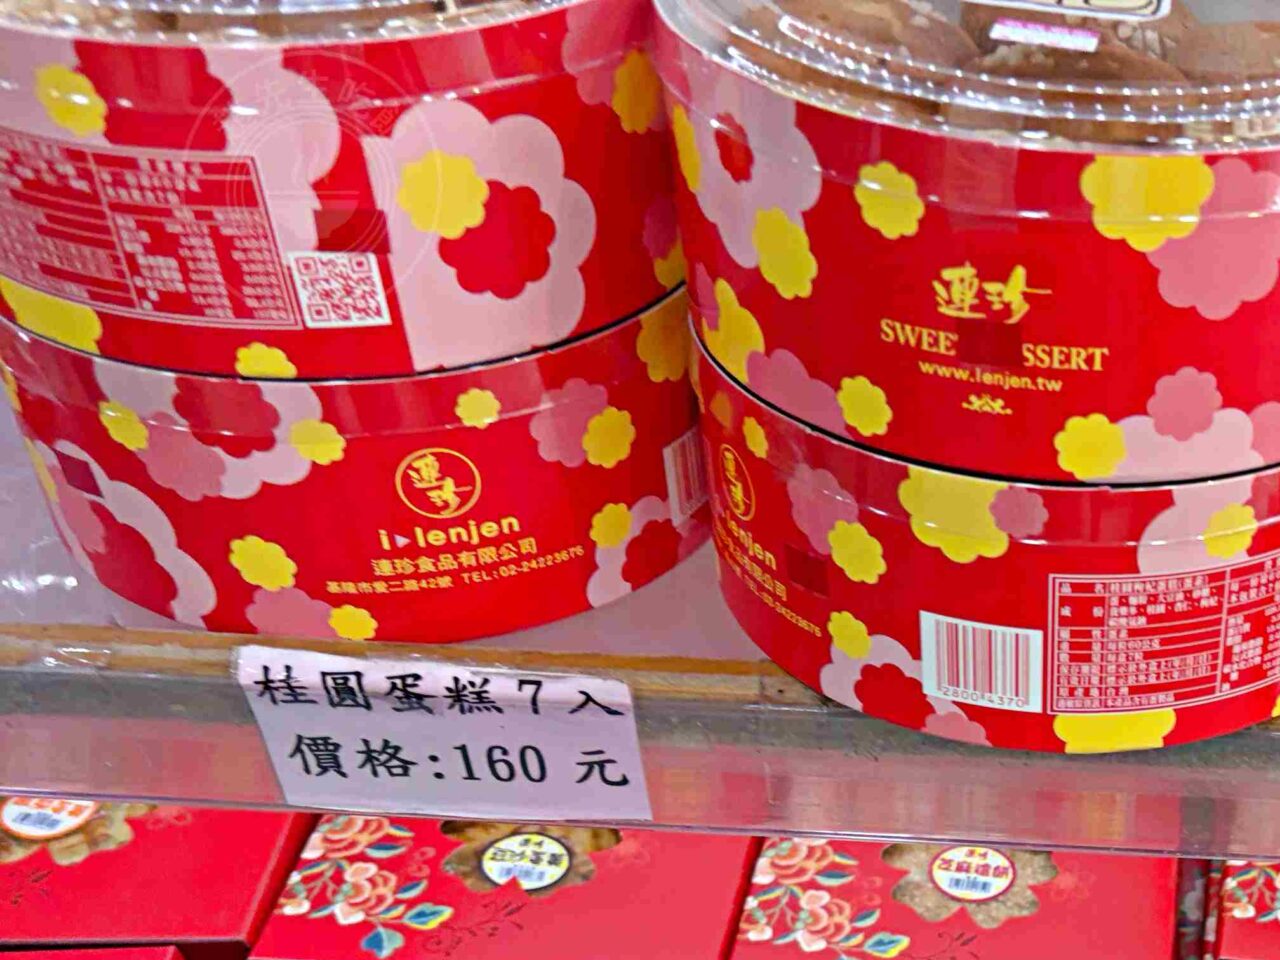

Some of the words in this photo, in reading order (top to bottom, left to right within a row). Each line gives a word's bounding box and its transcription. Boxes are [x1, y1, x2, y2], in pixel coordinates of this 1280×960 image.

[880, 318, 958, 356] SWEE
[918, 360, 1063, 392] www.lenjen.tw
[254, 664, 625, 717] 桂圓蛋糕7入
